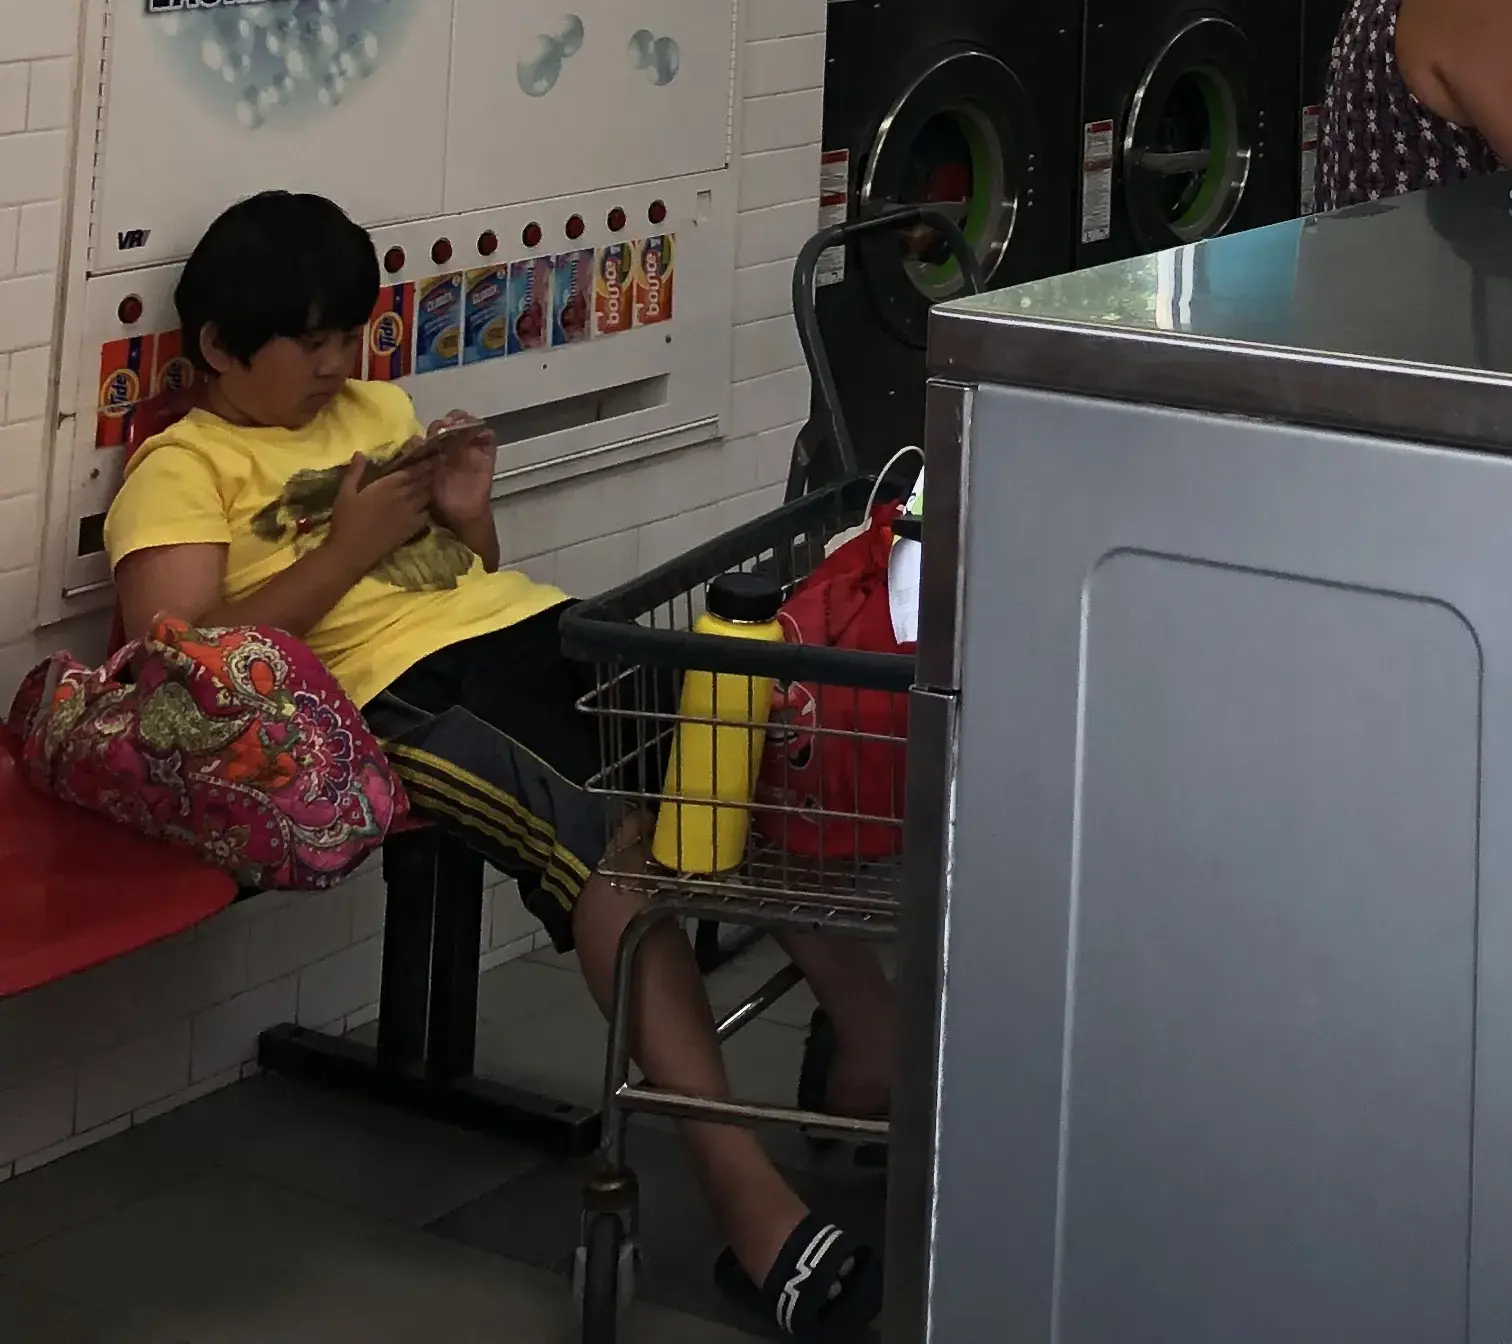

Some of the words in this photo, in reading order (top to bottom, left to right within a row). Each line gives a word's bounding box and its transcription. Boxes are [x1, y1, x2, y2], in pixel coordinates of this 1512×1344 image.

[605, 259, 620, 326] bounce
[646, 253, 660, 316] bounce
[378, 314, 398, 349] Tide
[165, 362, 183, 391] ide
